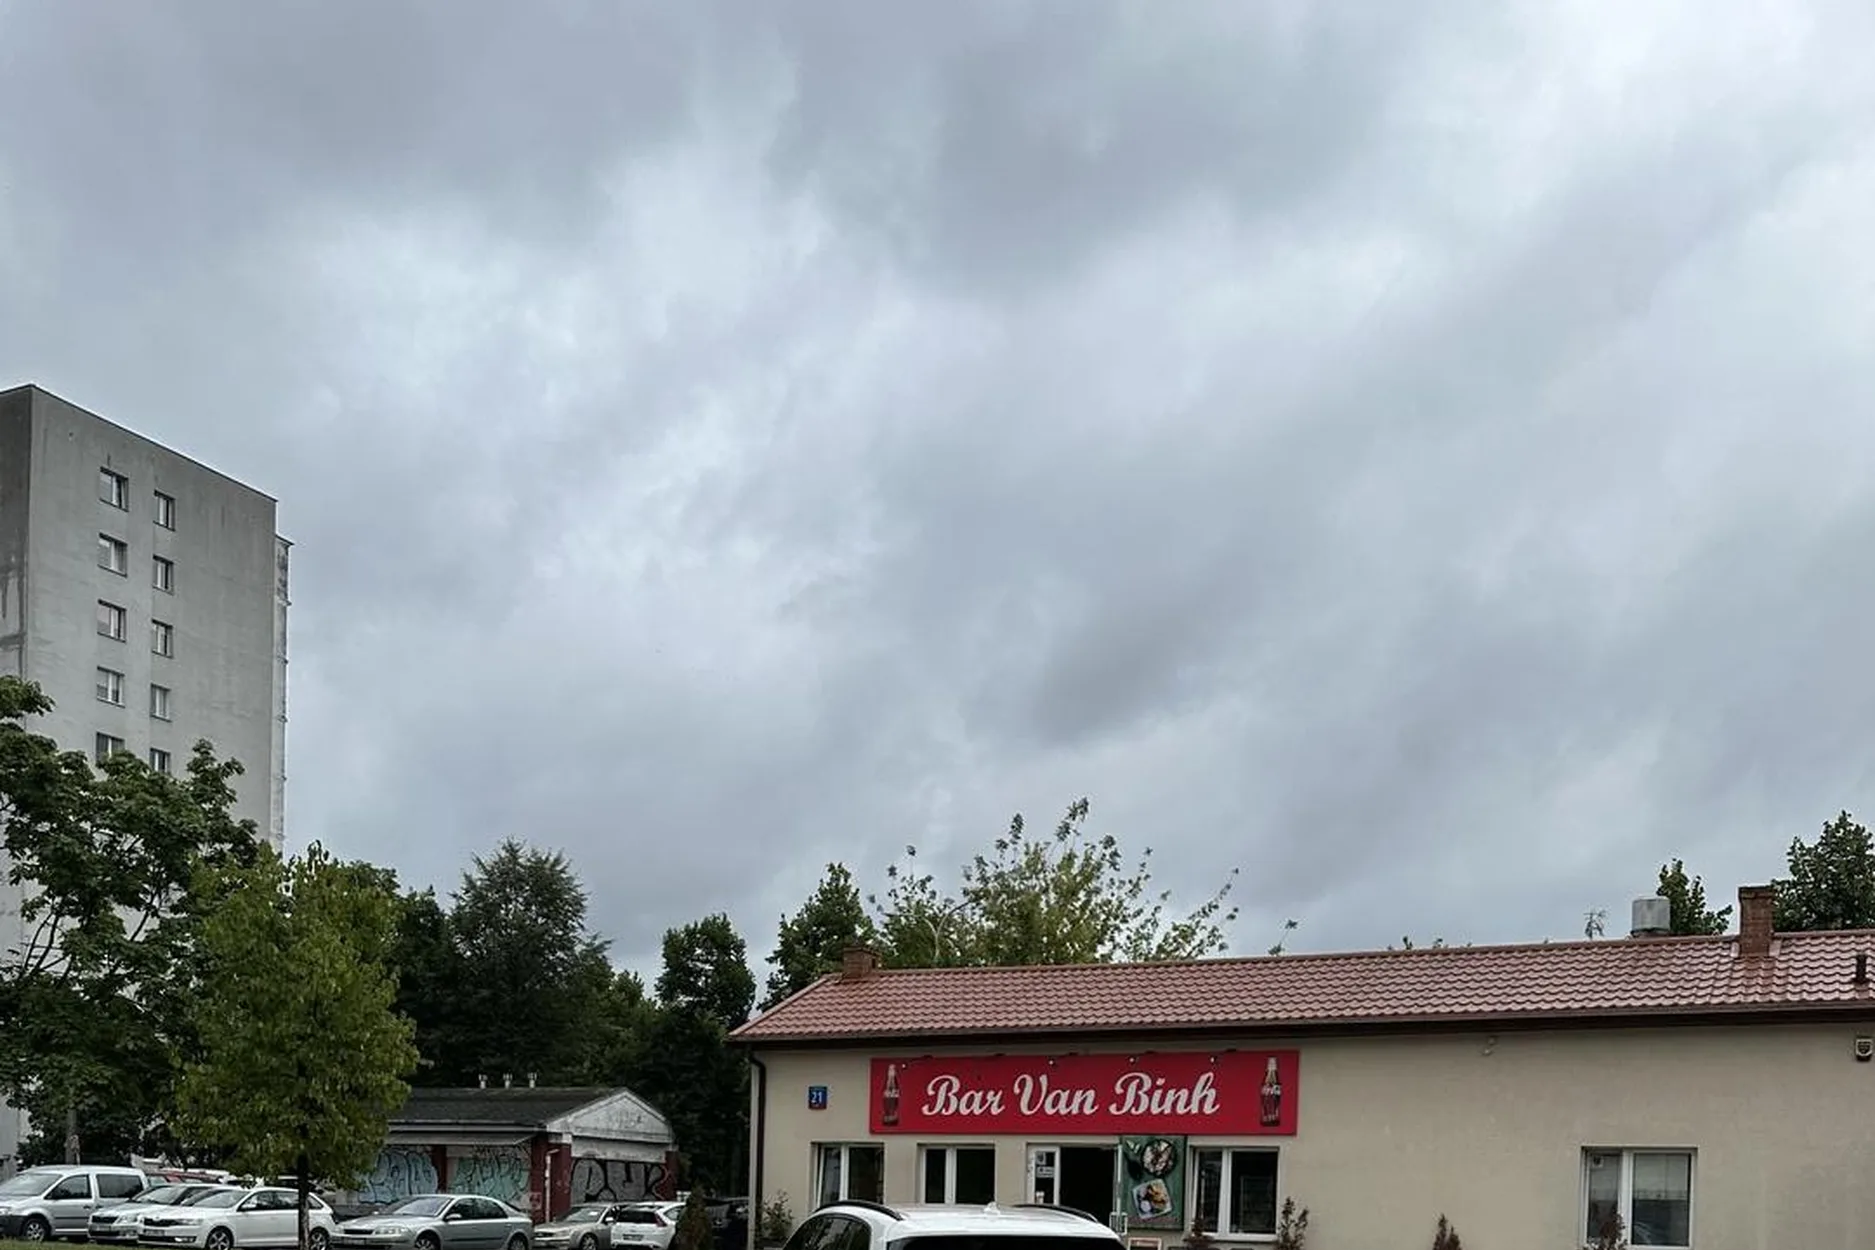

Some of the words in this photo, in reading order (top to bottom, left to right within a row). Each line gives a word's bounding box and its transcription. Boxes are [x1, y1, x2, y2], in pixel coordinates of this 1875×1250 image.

[811, 1091, 823, 1104] 21
[922, 1075, 1005, 1115] Bar
[1013, 1074, 1099, 1115] Van
[1109, 1072, 1220, 1115] Binh
